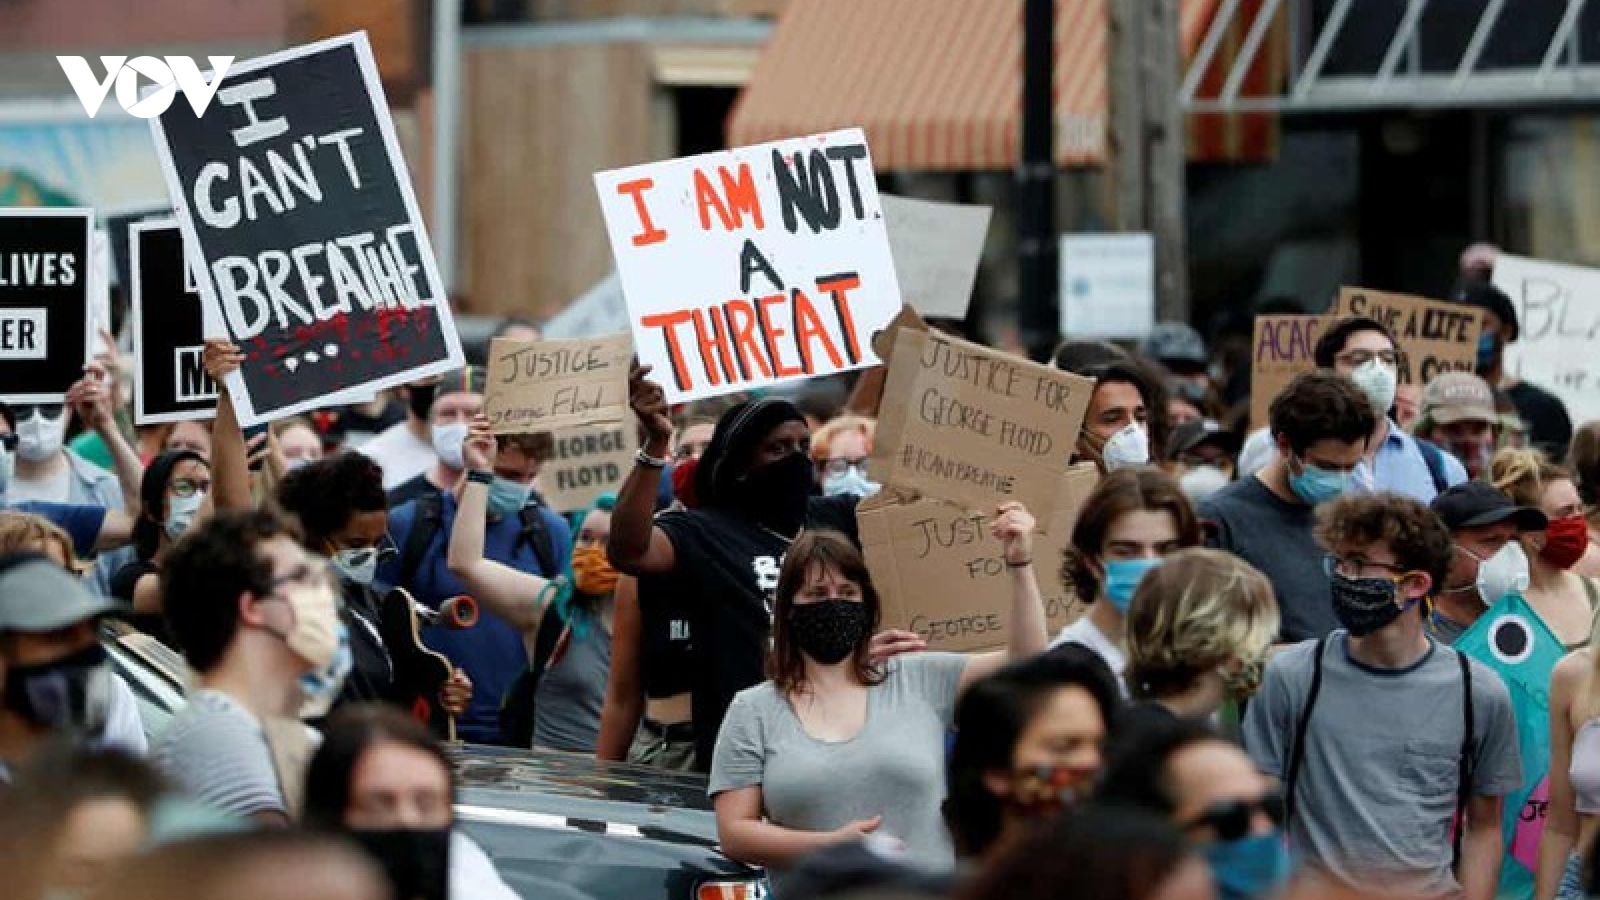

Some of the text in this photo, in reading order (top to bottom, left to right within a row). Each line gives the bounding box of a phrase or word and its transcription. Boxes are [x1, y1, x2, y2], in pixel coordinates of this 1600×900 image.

[217, 77, 290, 147] I
[194, 127, 363, 228] CAN'T
[617, 178, 668, 246] I
[693, 163, 765, 231] AM
[212, 225, 436, 340] BREATHE
[739, 238, 785, 294] A
[640, 271, 860, 391] THREAT
[1404, 311, 1417, 339] A
[1421, 308, 1473, 343] LIFE
[500, 346, 608, 383] JUSTICE
[920, 336, 1071, 414] JUSTICE FOR
[558, 430, 625, 459] EORGE
[919, 387, 1052, 456] GEORGE FLOYD
[556, 463, 618, 490] FLOYD
[910, 613, 1003, 642] GEORGE
